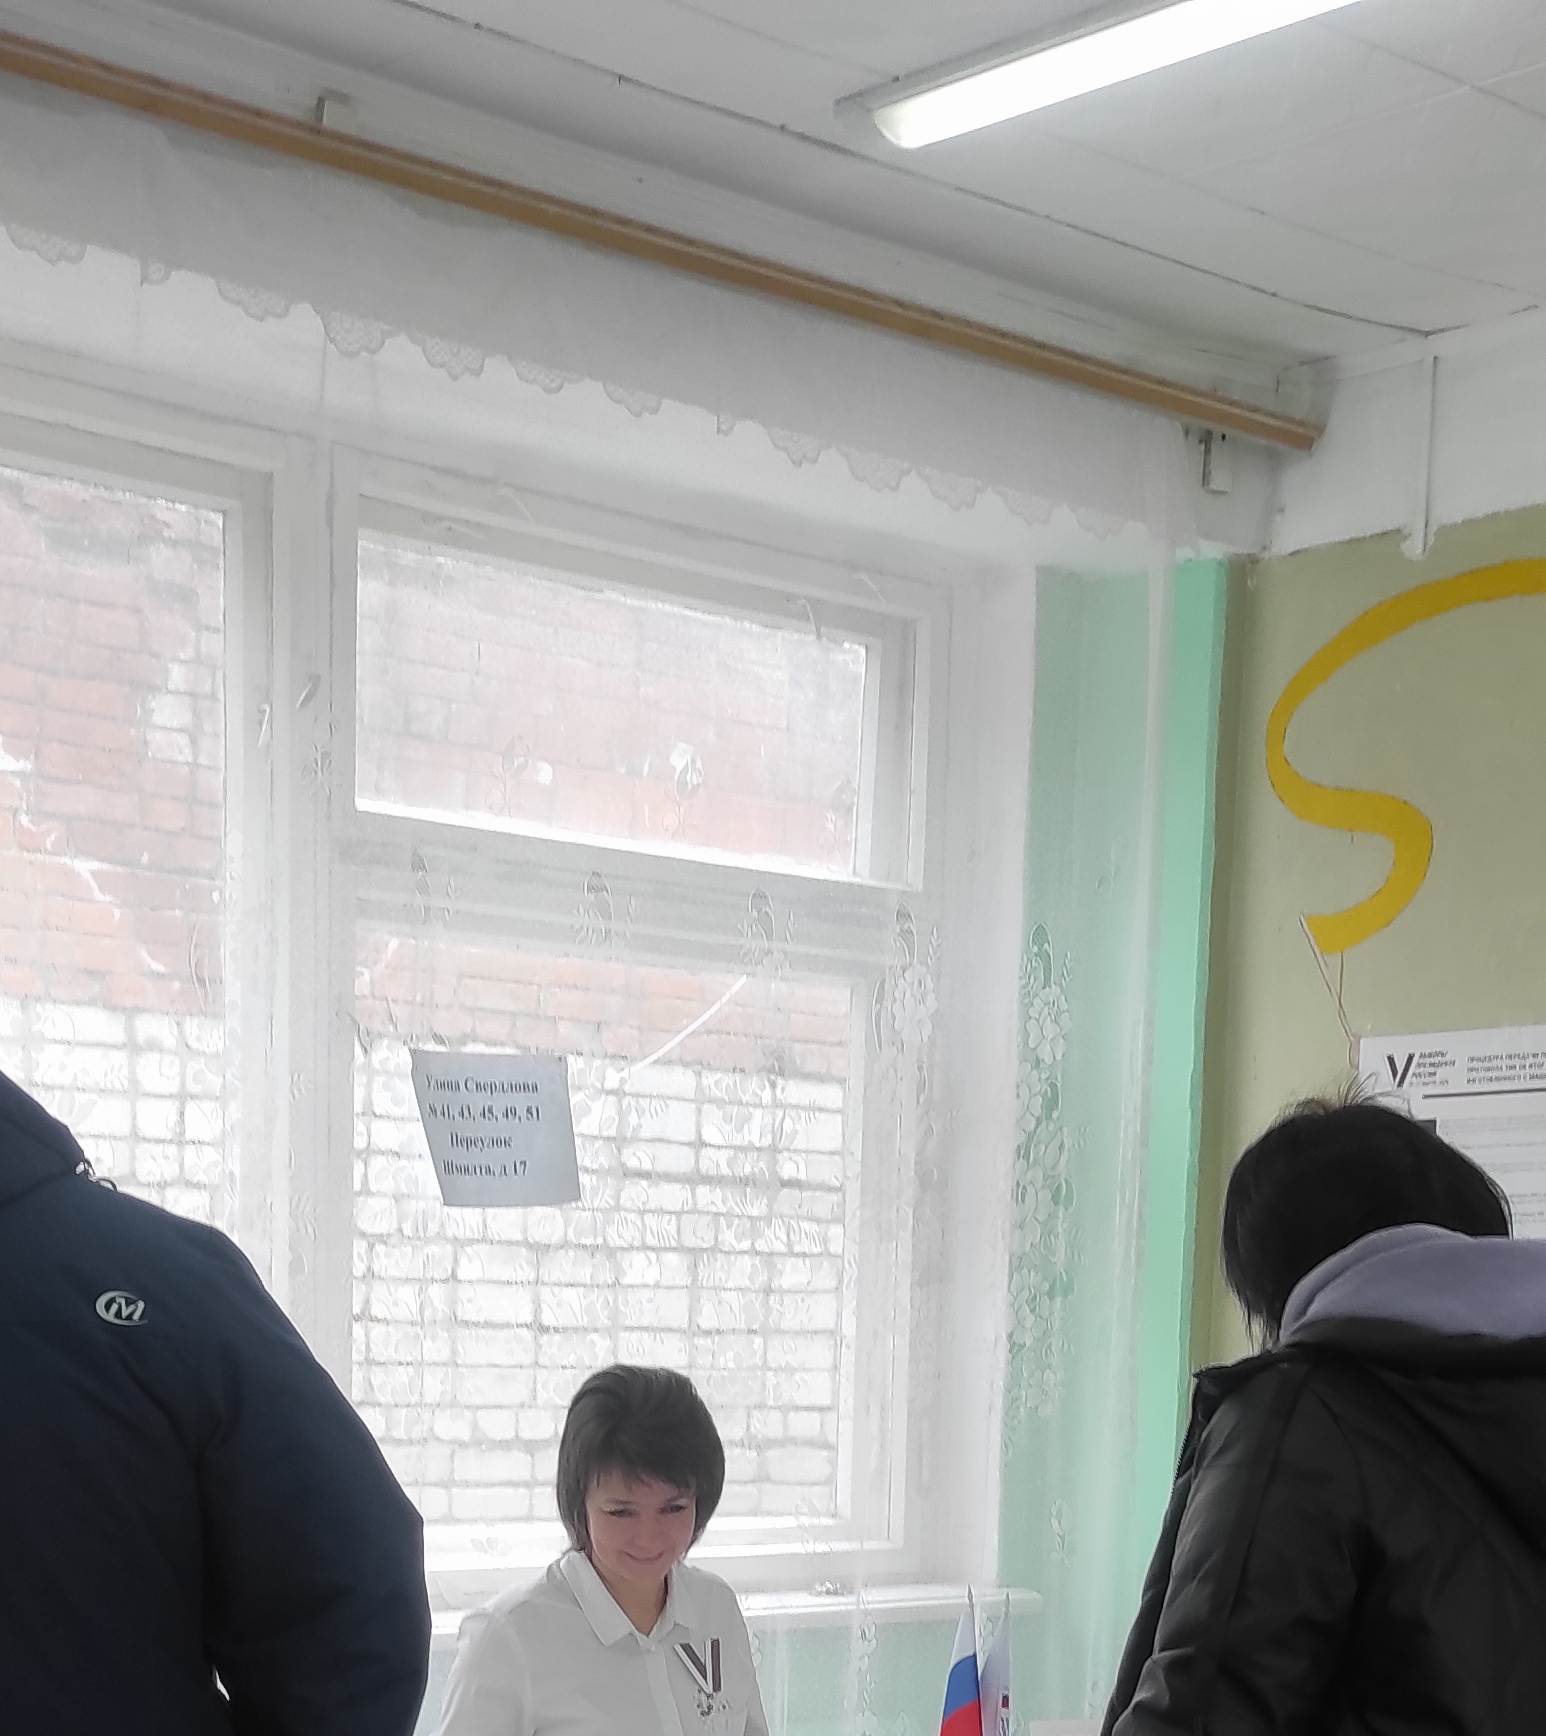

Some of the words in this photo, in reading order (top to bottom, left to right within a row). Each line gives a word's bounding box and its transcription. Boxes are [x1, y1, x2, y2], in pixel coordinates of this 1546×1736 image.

[425, 1074, 461, 1094] Улица
[464, 1075, 539, 1097] Свердлова
[449, 1132, 513, 1152] Переулок
